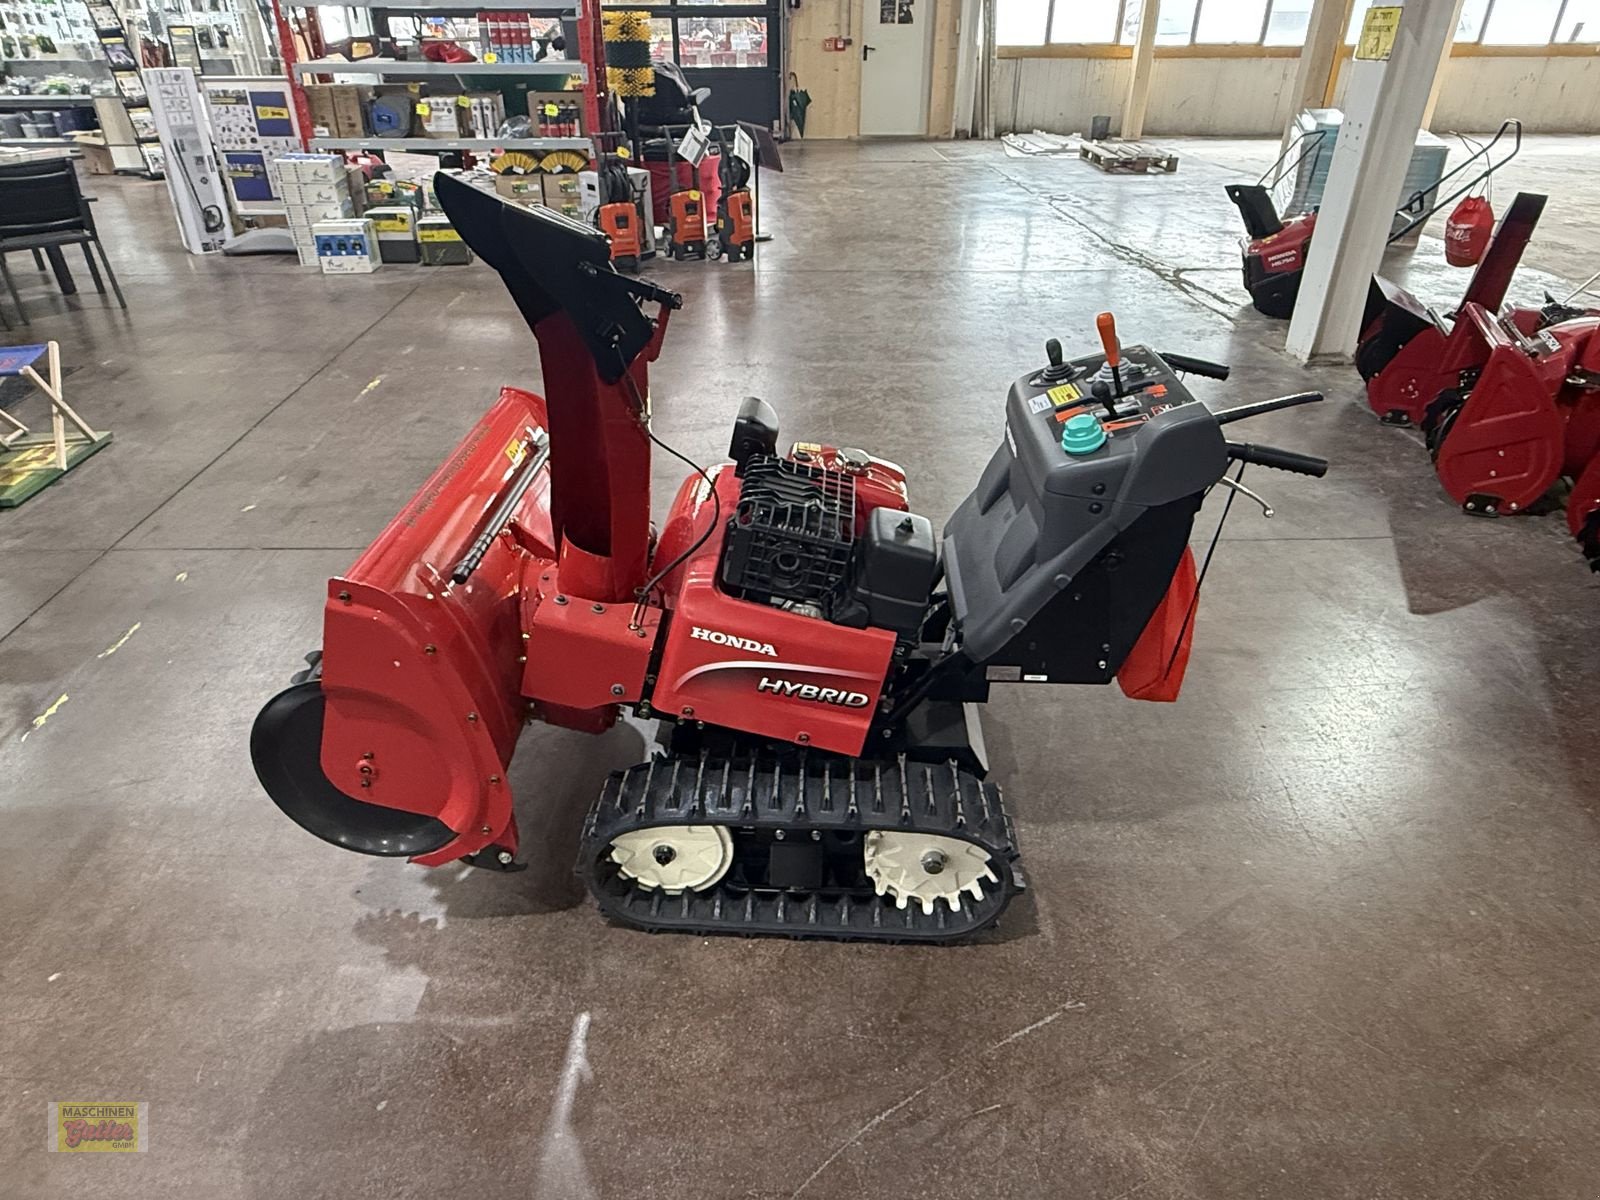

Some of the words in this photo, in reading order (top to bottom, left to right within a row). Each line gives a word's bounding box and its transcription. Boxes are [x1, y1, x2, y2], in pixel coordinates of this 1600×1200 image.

[1268, 250, 1297, 261] HONDA
[690, 627, 778, 657] HONDA
[757, 677, 869, 708] HYBRID
